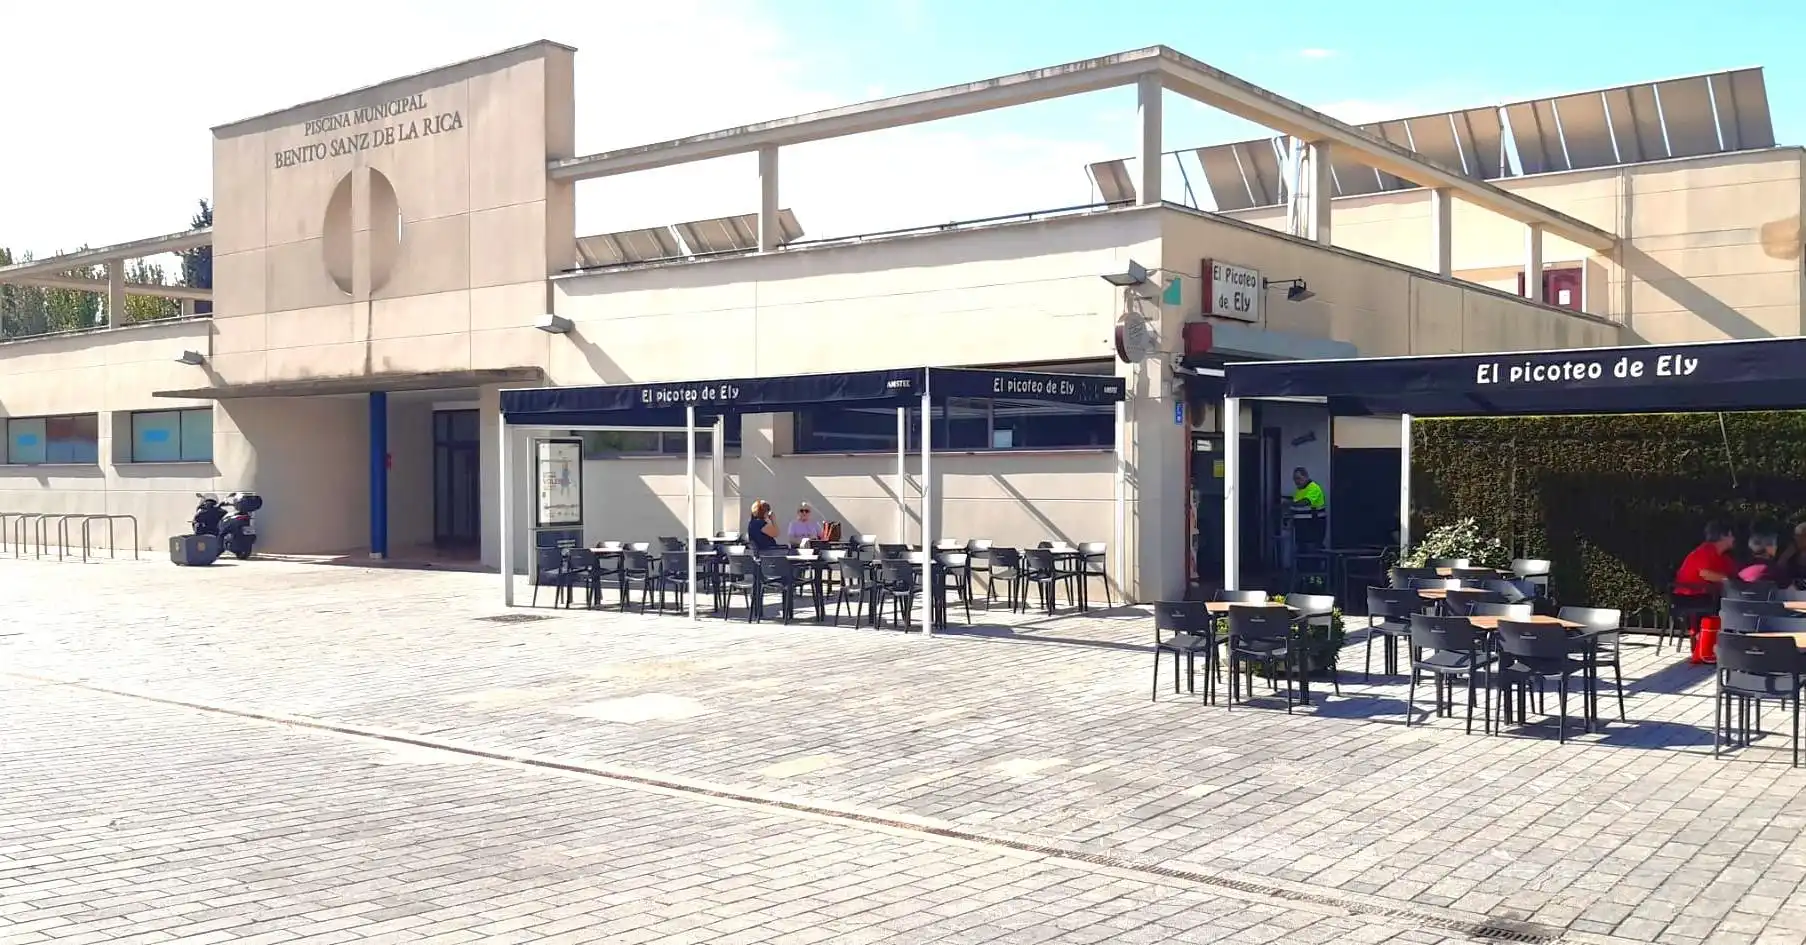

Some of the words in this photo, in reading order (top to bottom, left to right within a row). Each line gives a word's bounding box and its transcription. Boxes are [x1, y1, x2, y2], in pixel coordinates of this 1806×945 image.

[305, 114, 351, 136] PISCINA
[353, 94, 427, 125] MUNICIPAL
[275, 142, 327, 169] BENITO
[330, 133, 370, 157] SANZ
[373, 126, 395, 149] DE
[398, 119, 420, 142] LA
[423, 110, 464, 137] RICA
[1213, 265, 1222, 281] El
[1225, 267, 1256, 288] Picoteo
[1218, 293, 1229, 309] de
[1234, 291, 1251, 312] Ely
[1476, 363, 1499, 384] El
[1510, 360, 1602, 382] picoteo
[1613, 357, 1644, 378] de
[1656, 354, 1698, 376] Ely
[642, 389, 653, 403] El
[656, 387, 697, 403] picoteo
[701, 386, 716, 400] de
[720, 384, 739, 400] Ely
[993, 377, 1004, 393] El
[1007, 378, 1043, 393] picoteo
[1046, 379, 1057, 394] de
[1060, 380, 1075, 395] Ely
